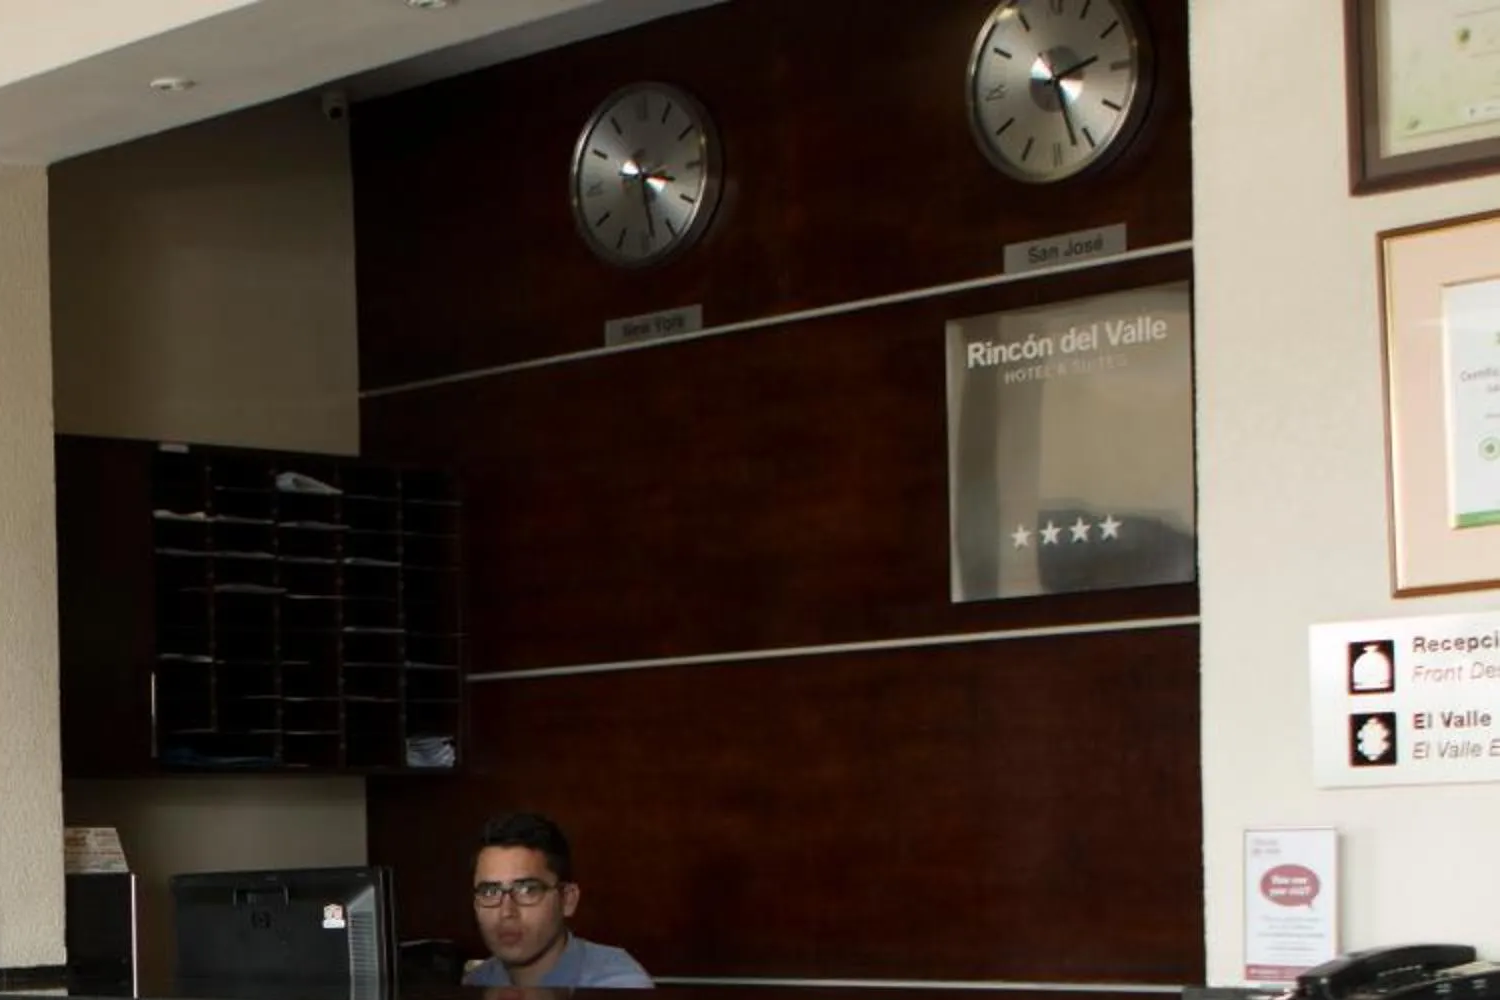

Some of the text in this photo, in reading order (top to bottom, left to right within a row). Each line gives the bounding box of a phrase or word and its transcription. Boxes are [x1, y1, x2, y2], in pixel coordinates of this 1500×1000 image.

[1027, 231, 1105, 264] San José
[967, 315, 1169, 369] Rincón del Valle
[1412, 630, 1500, 653] Recepci
[1411, 664, 1463, 682] Front
[1412, 709, 1493, 730] El Valle
[1412, 740, 1430, 759] El
[1437, 739, 1483, 758] Valle
